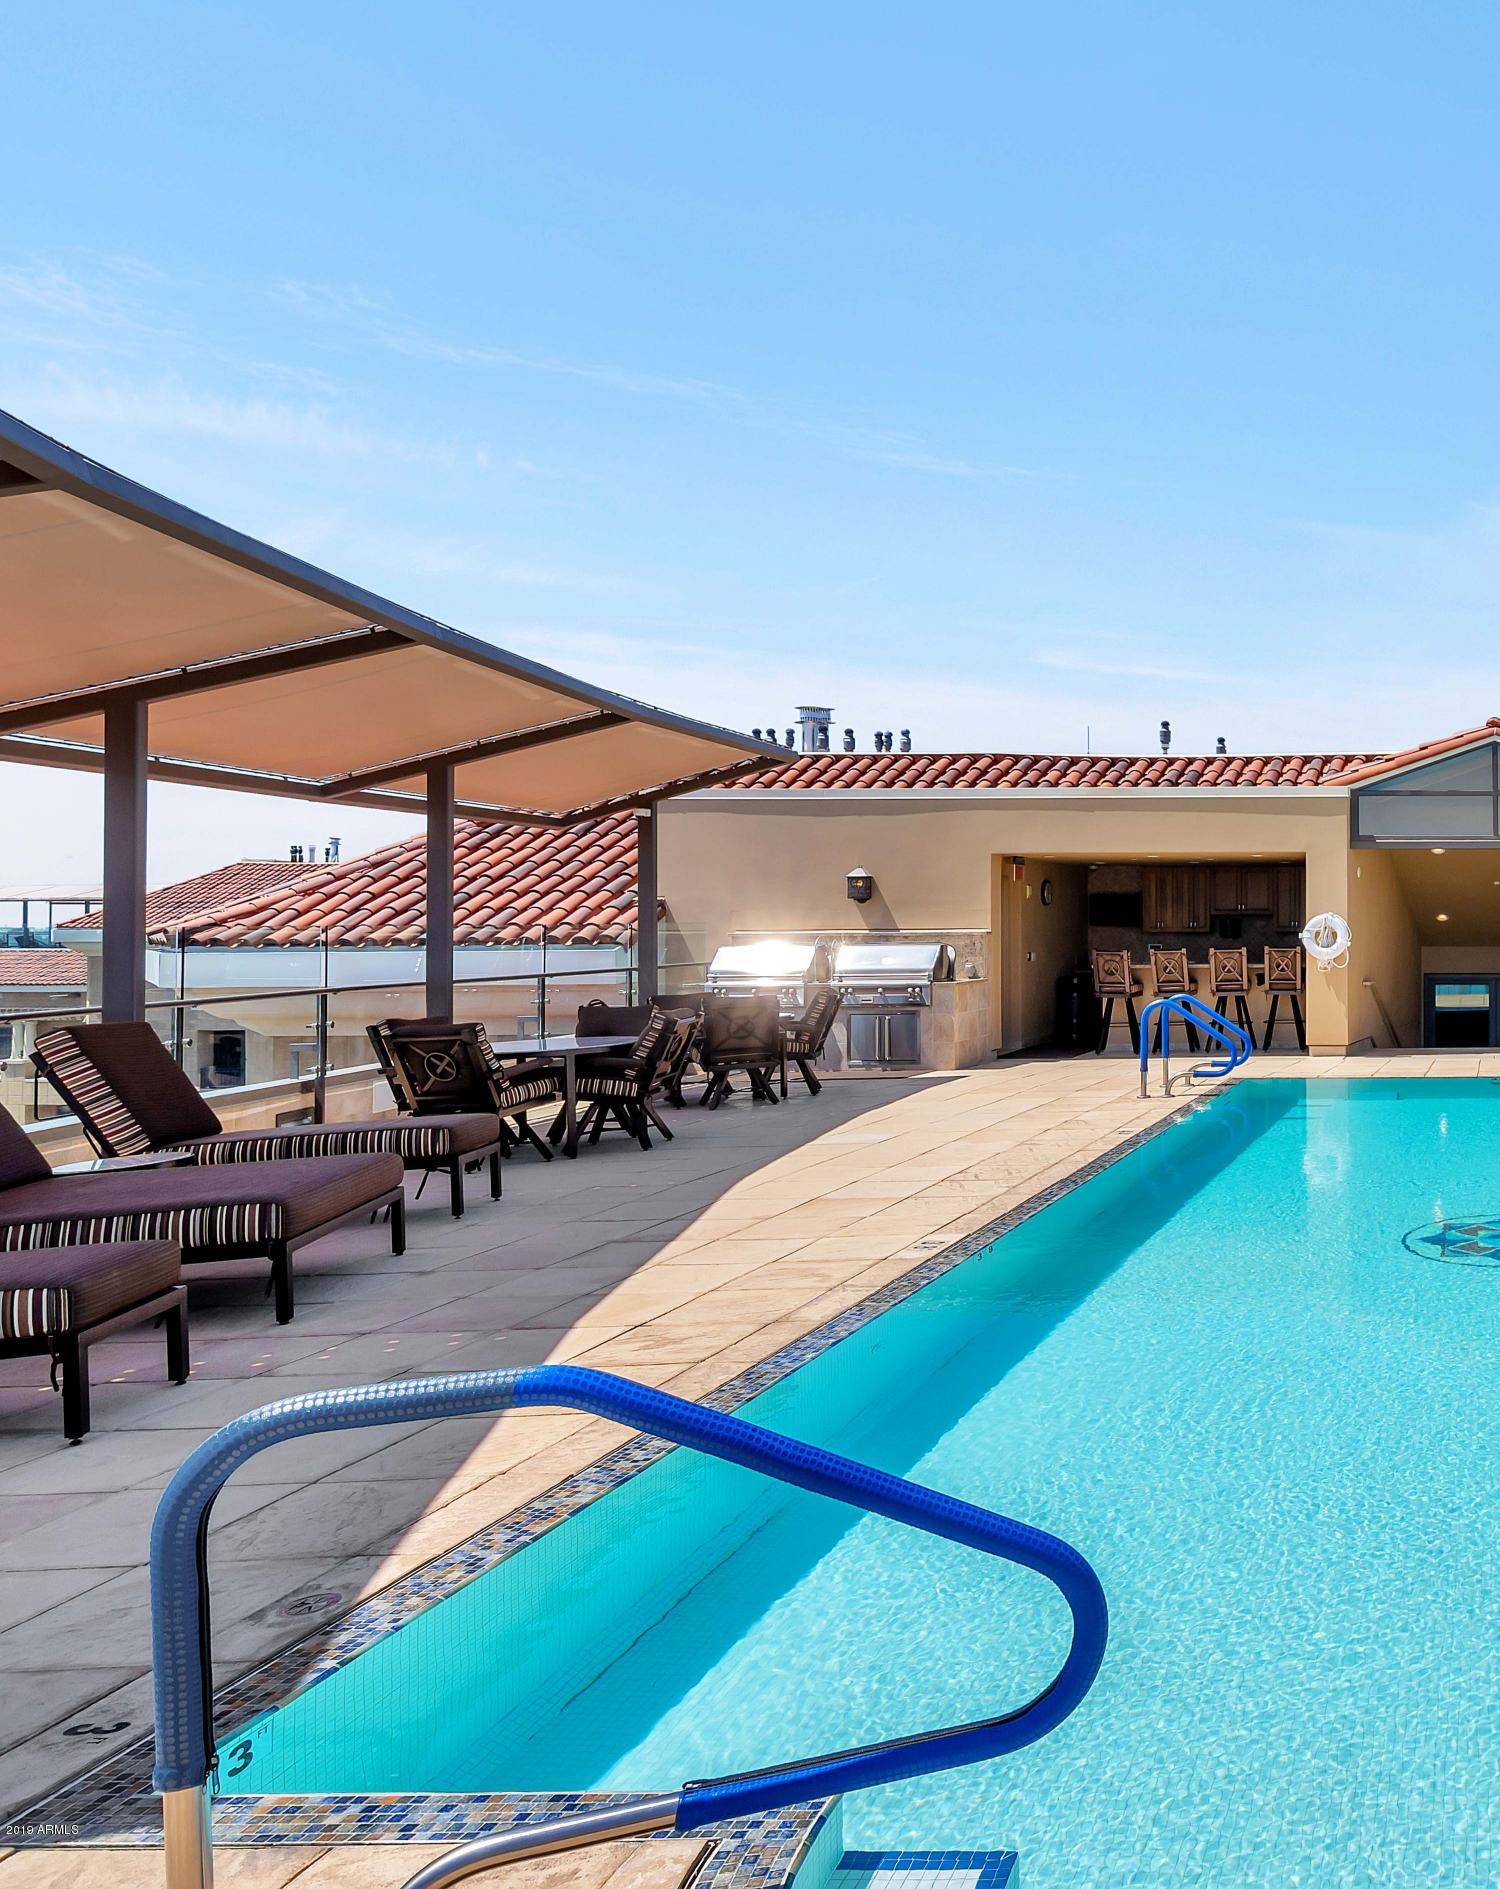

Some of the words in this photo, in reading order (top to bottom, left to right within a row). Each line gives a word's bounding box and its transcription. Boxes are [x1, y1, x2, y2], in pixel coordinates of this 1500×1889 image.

[63, 1721, 132, 1736] 3
[227, 1739, 254, 1778] 3
[257, 1723, 270, 1739] FT
